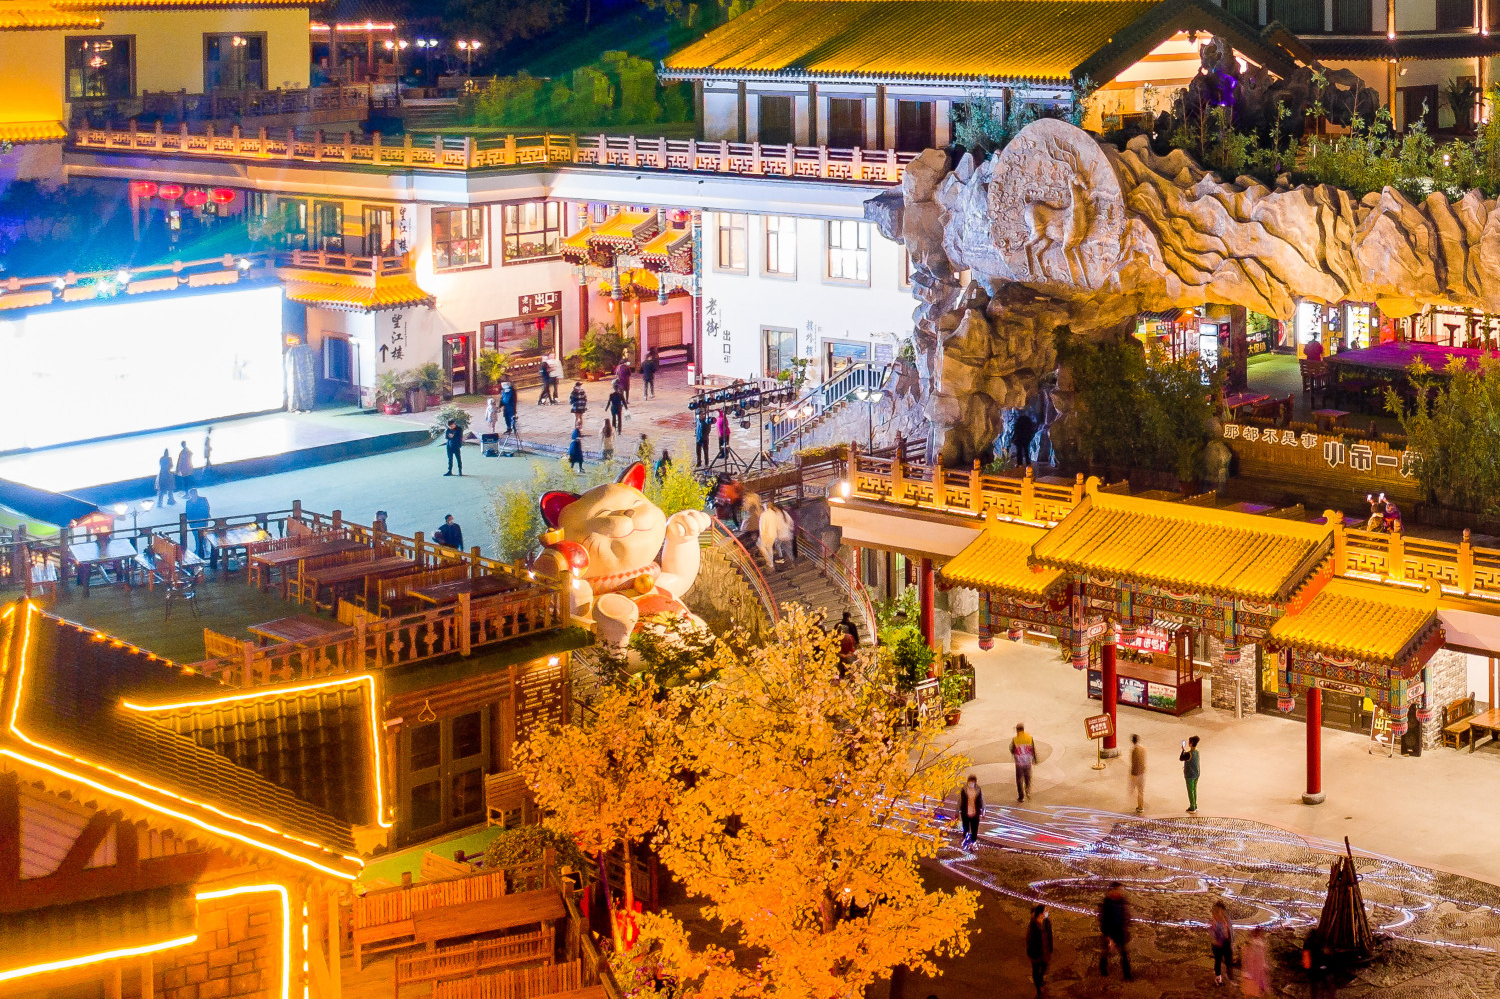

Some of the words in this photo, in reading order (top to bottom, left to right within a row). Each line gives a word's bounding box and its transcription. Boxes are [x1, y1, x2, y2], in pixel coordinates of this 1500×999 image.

[399, 206, 409, 253] 望江楼
[521, 296, 529, 313] 老街
[534, 293, 554, 305] 出口
[705, 297, 719, 337] 老街
[391, 314, 404, 360] 望江楼
[722, 330, 731, 355] 出口
[1223, 424, 1318, 449] 那都不是事
